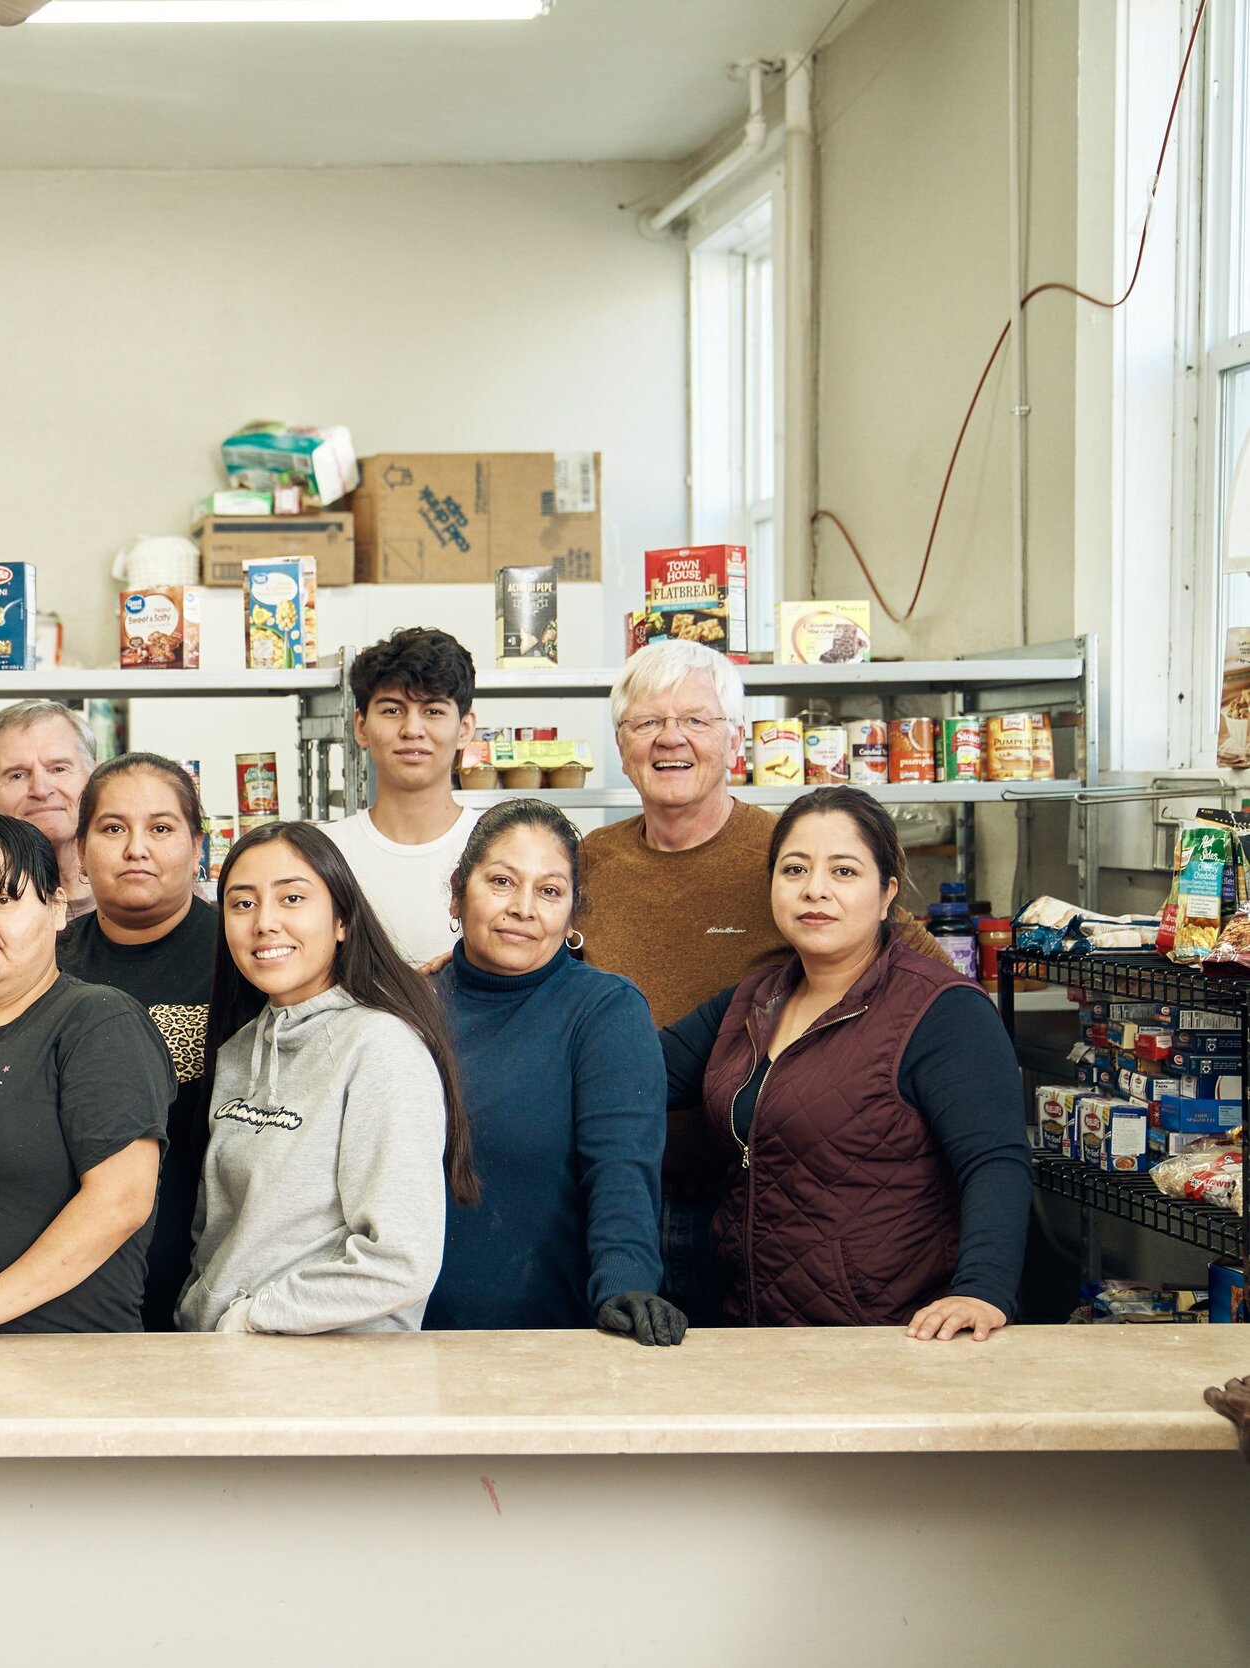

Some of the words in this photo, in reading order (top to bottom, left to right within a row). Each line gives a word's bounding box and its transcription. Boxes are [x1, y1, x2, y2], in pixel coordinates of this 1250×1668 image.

[667, 560, 700, 571] TOWN
[667, 571, 701, 583] HOUSE
[537, 583, 552, 592] PEPE
[654, 584, 716, 600] FLATBREAD
[128, 615, 149, 625] Sweet
[154, 613, 171, 623] Salty
[1193, 871, 1218, 880] Cheddar
